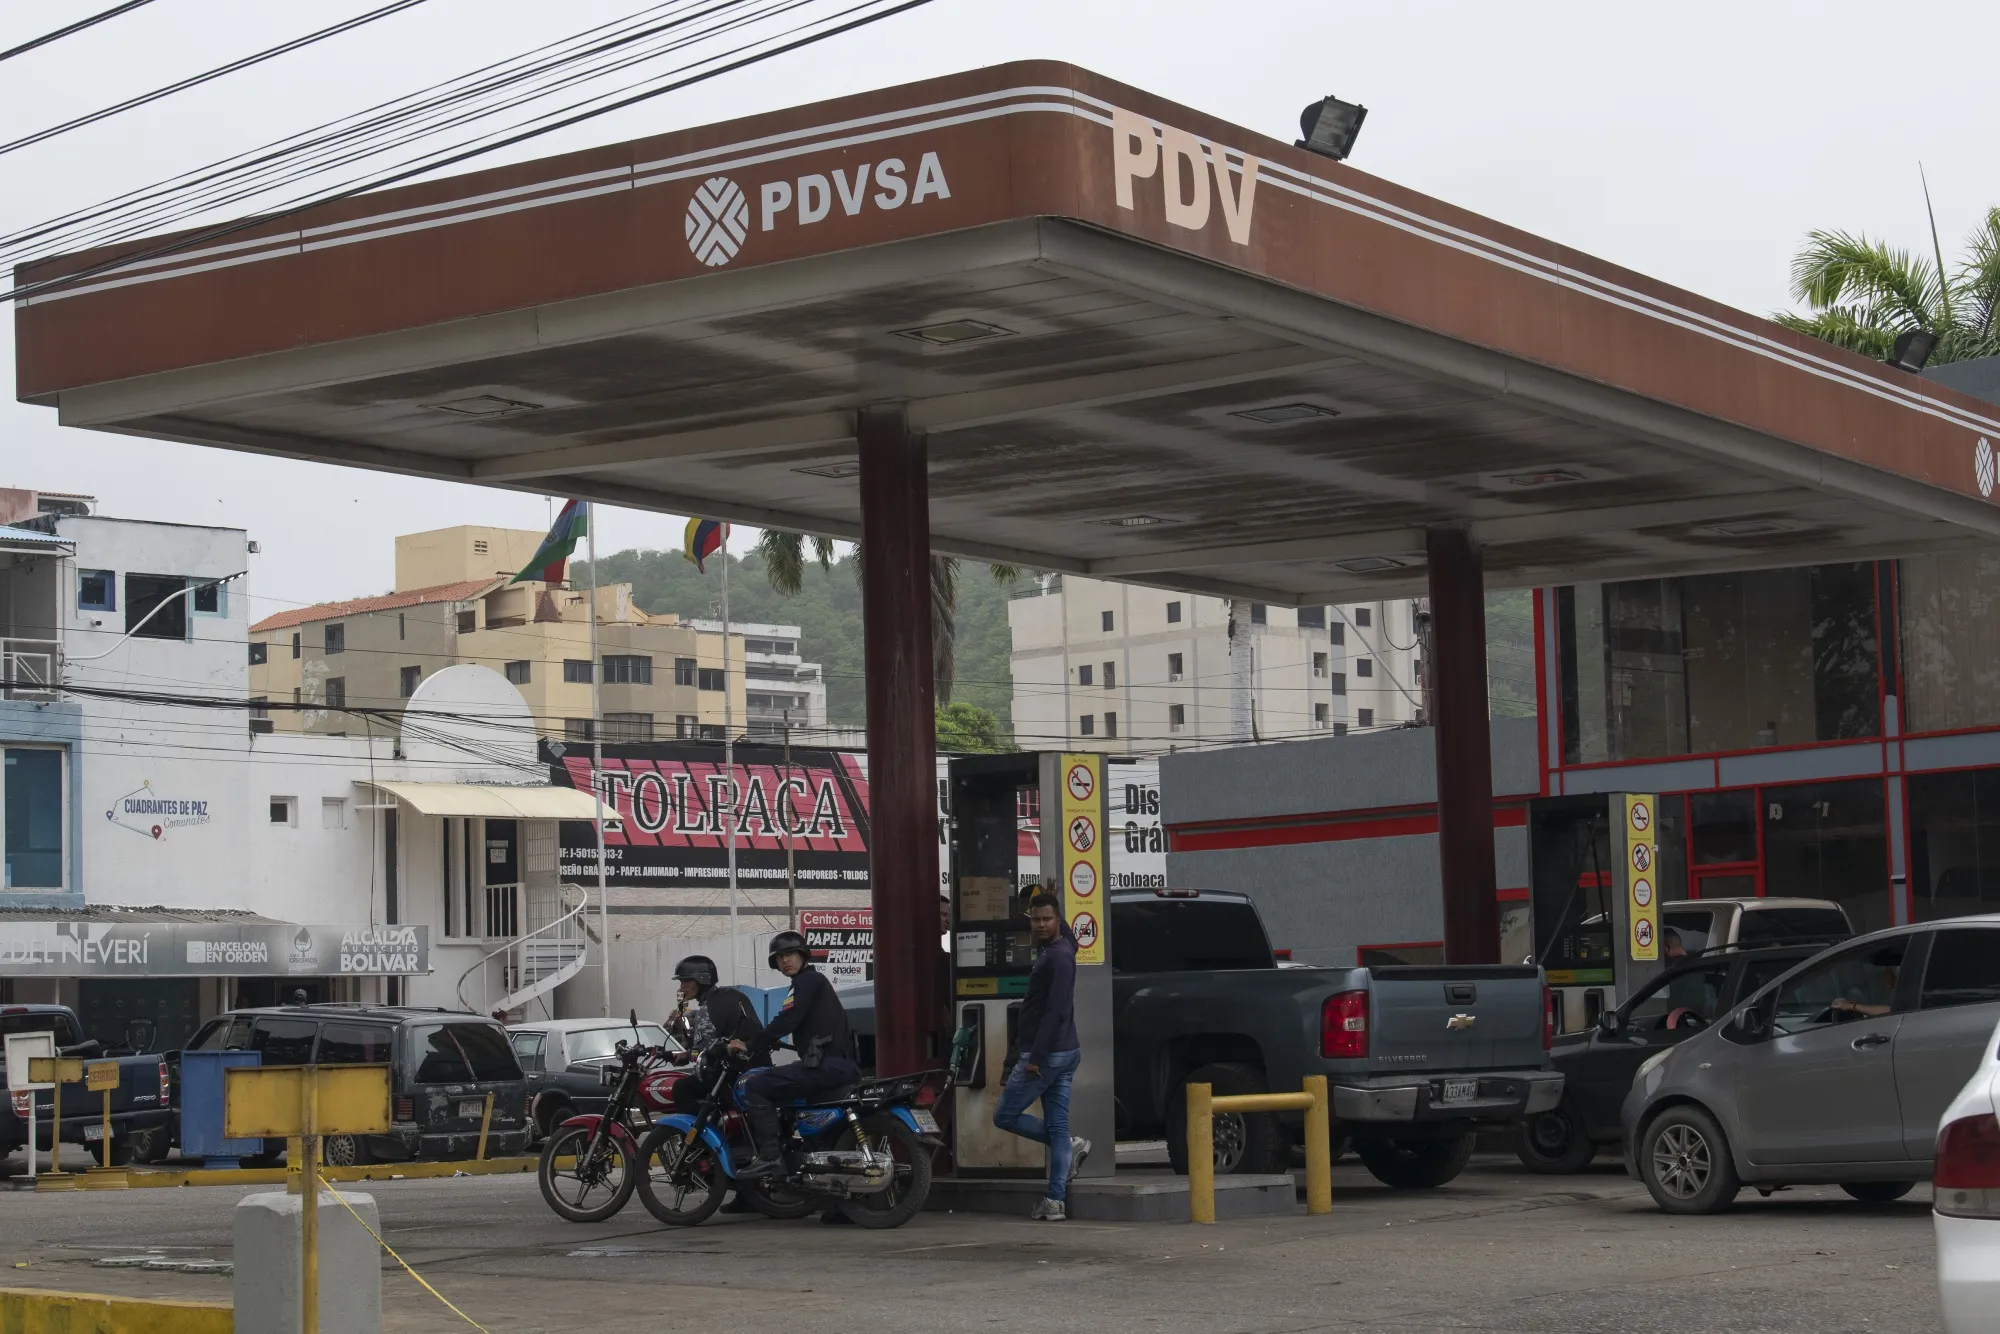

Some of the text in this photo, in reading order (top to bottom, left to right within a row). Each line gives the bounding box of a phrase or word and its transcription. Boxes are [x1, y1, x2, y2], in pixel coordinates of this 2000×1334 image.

[1112, 106, 1259, 246] PDV
[760, 151, 951, 231] PDVSA
[124, 799, 208, 816] CUADRANTES DE PAZ
[163, 815, 212, 829] Comunales
[583, 864, 615, 876] GRÁCO
[621, 866, 642, 877] PAPEL
[643, 867, 679, 877] AHUMADO
[684, 867, 730, 878] IMPRESIONES
[737, 868, 789, 879] GIGANTOGRAFÍ
[797, 869, 838, 880] CORPOREOS
[843, 870, 869, 880] TOLDOS
[803, 913, 873, 925] Centro de Ins
[806, 932, 873, 946] PAPEL AHU
[10, 931, 151, 965] DEL NEVERÍ
[207, 941, 268, 952] BARCELONA
[341, 945, 419, 953] MUNICIPIO
[206, 951, 268, 963] EN ORDEN
[340, 951, 419, 972] BOLÍVAR
[832, 965, 857, 974] shade
[1378, 1054, 1427, 1062] SILVERADO
